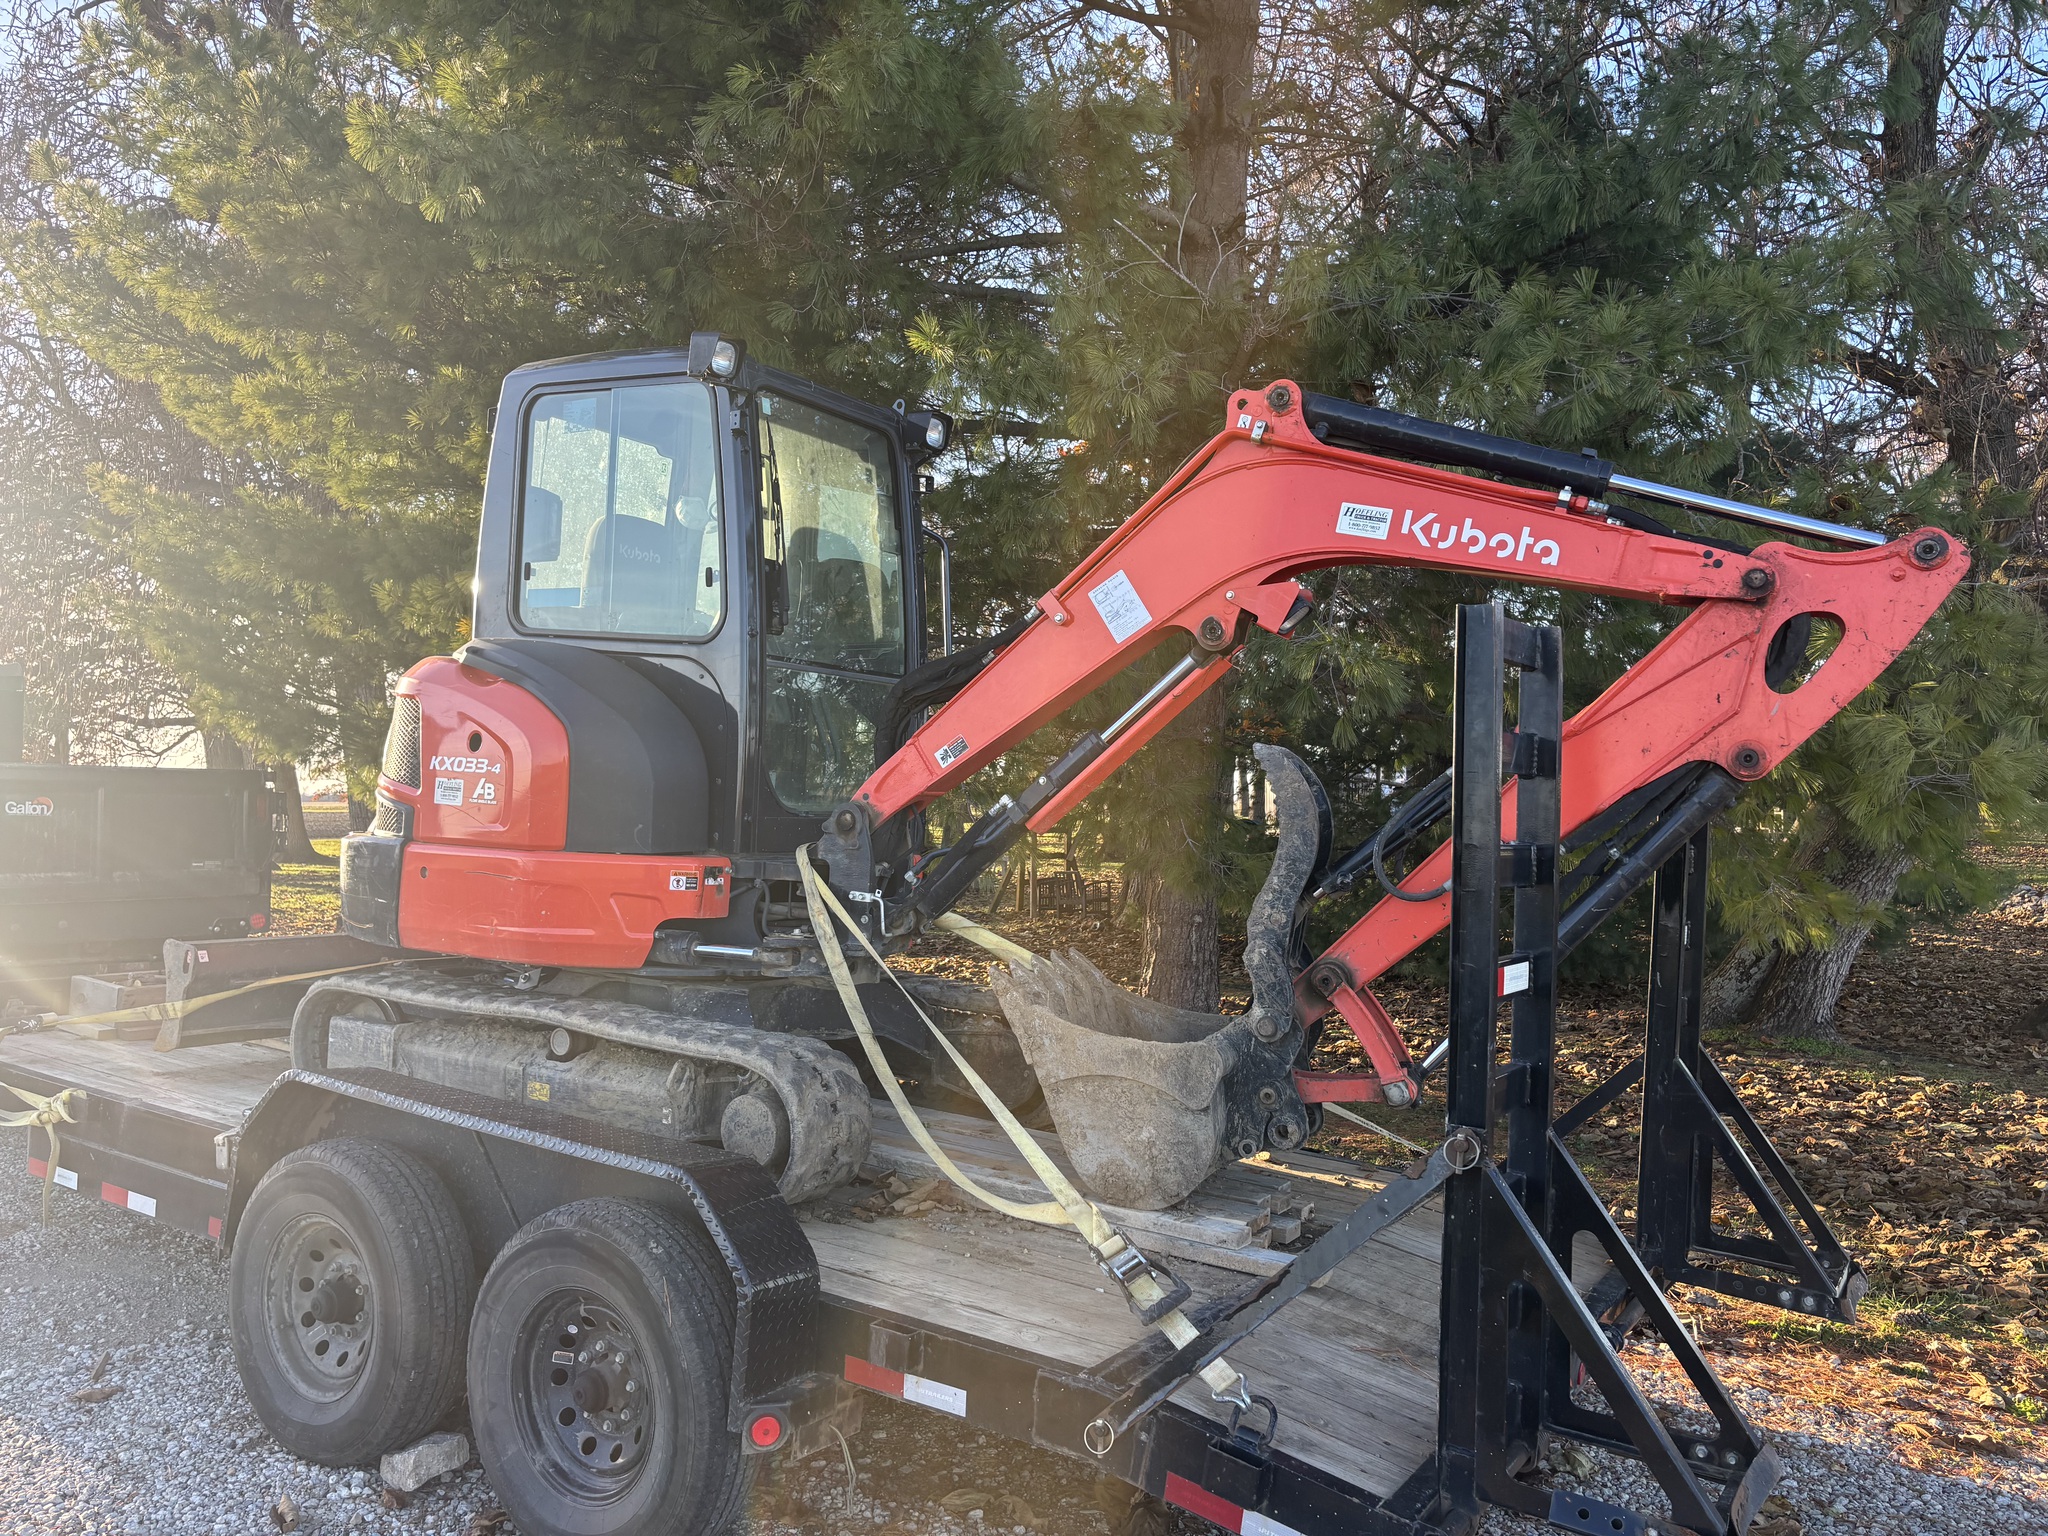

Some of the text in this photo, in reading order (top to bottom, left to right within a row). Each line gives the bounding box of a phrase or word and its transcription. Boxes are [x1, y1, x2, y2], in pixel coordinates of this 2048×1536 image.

[1401, 509, 1561, 566] Kubota
[619, 543, 661, 564] Kubota
[429, 755, 501, 774] KX033-4
[472, 777, 496, 800] AB
[5, 801, 47, 815] Galion
